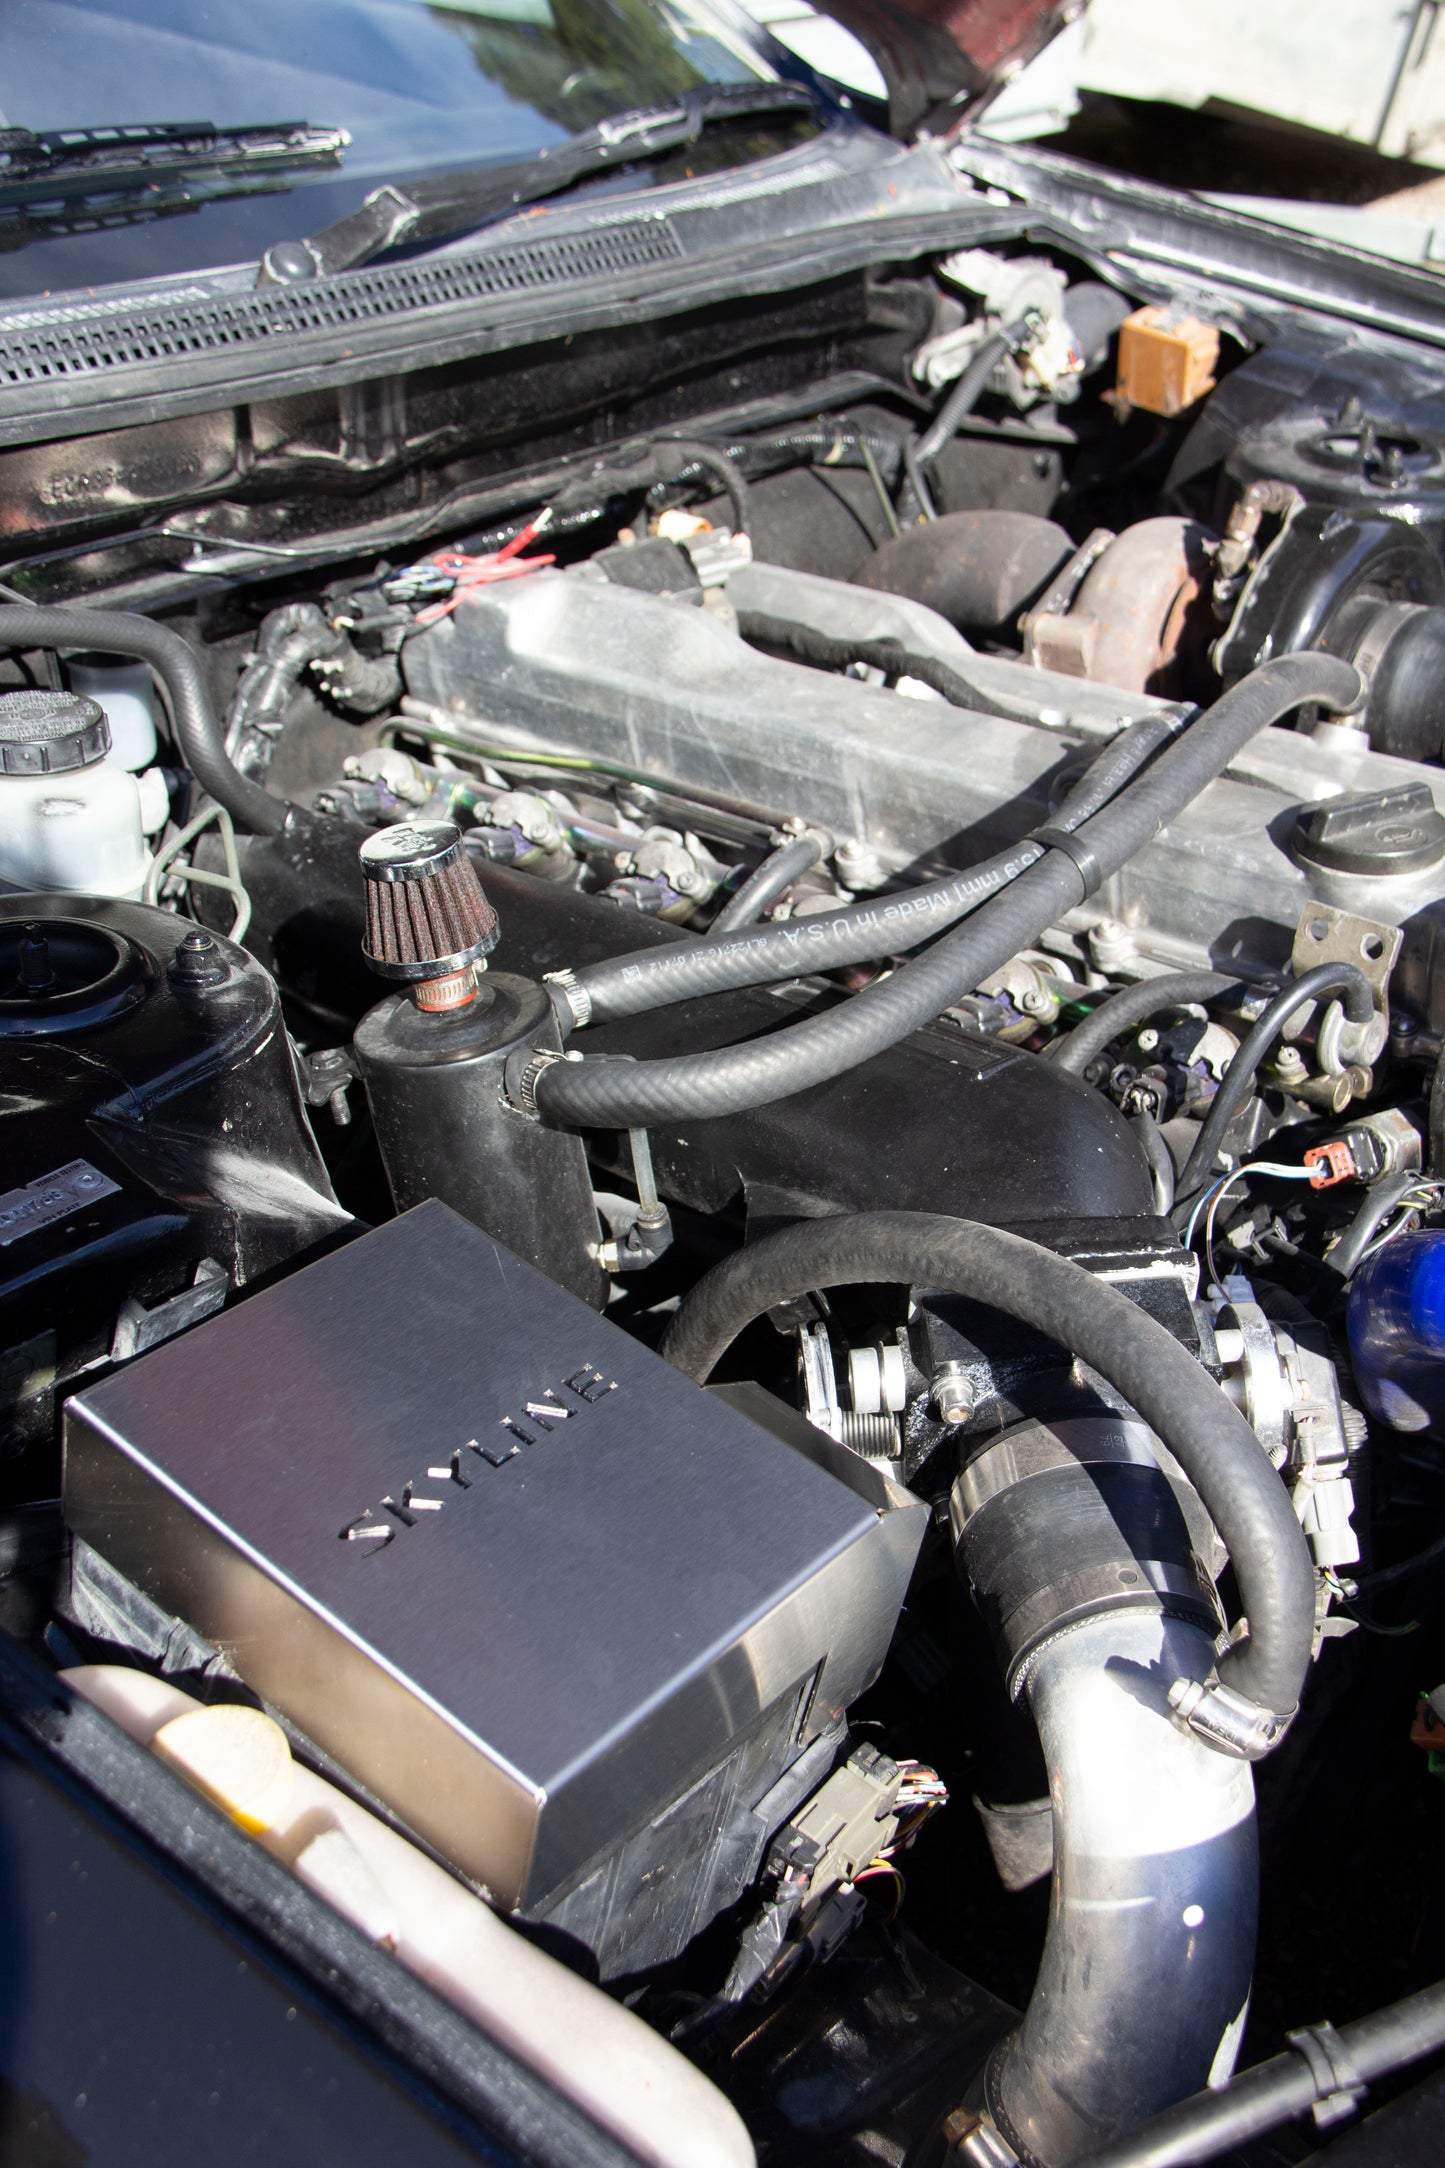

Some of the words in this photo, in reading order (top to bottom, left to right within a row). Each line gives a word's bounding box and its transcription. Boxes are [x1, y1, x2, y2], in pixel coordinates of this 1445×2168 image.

[884, 890, 951, 919] Made
[778, 919, 851, 946] U.S.A.
[856, 911, 878, 927] in
[337, 1361, 619, 1559] SKYLINE
